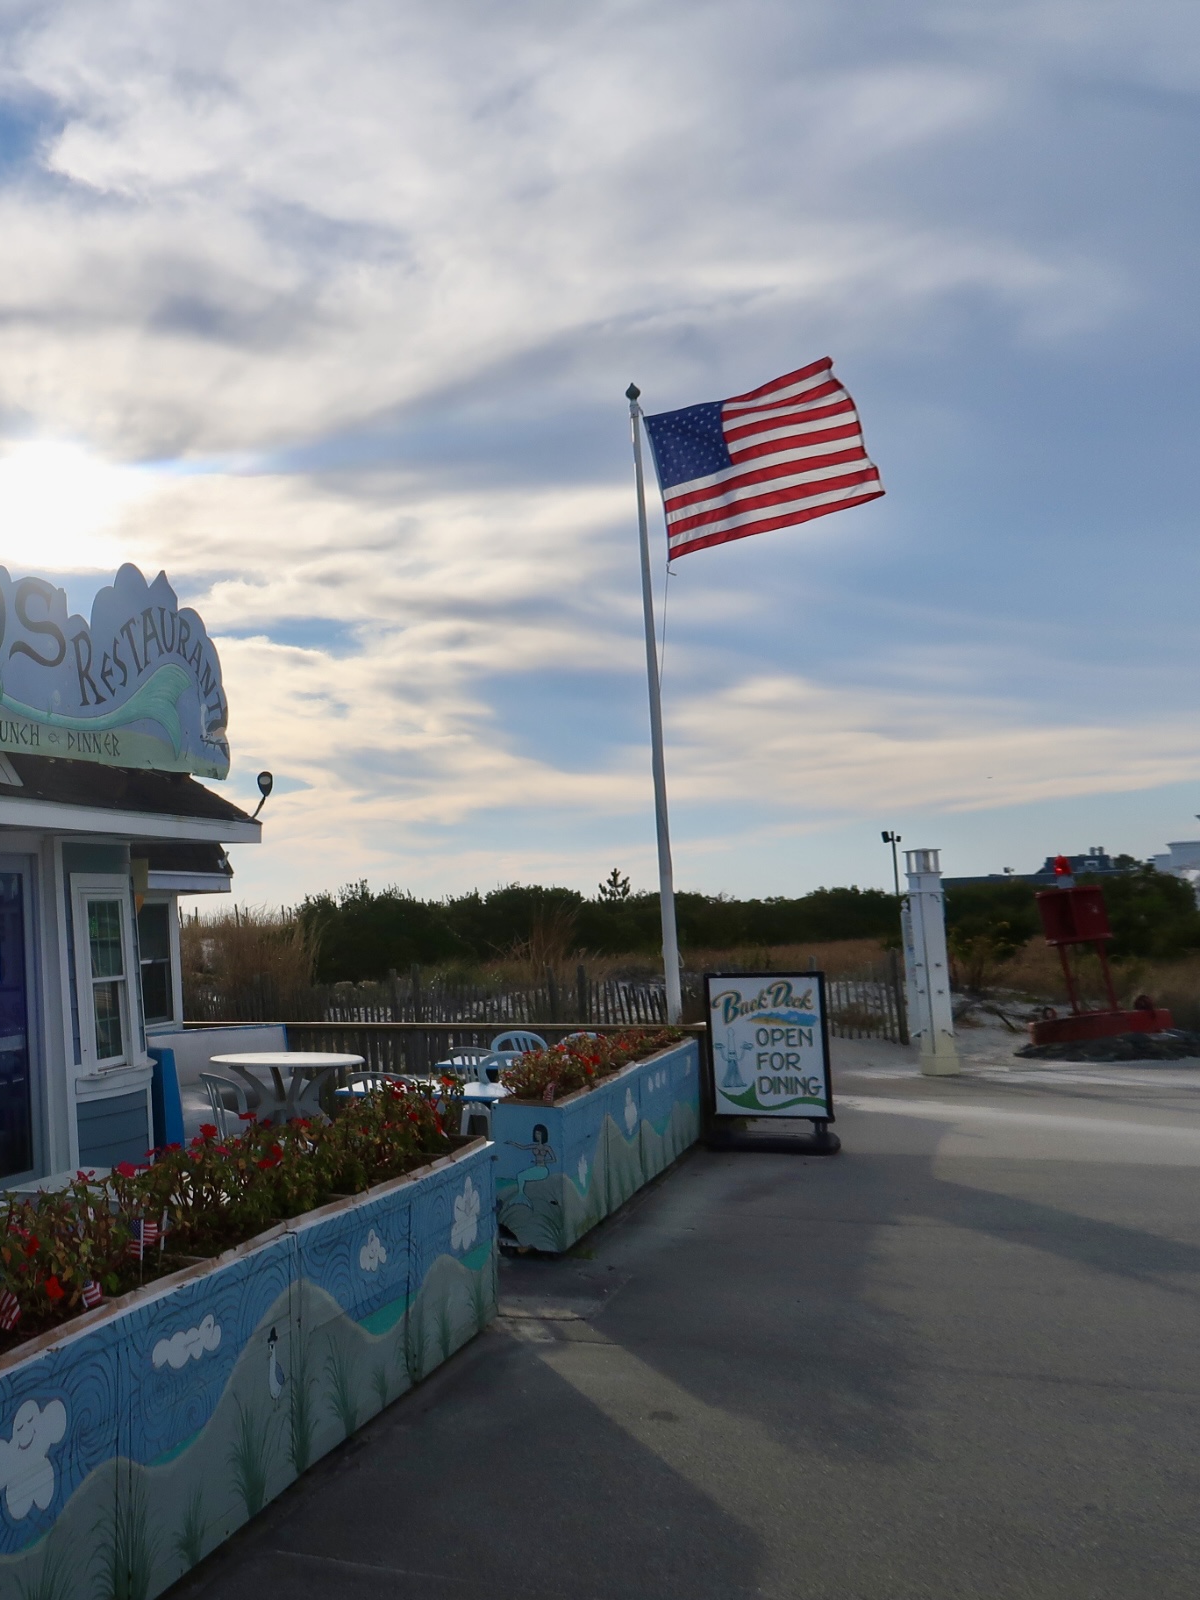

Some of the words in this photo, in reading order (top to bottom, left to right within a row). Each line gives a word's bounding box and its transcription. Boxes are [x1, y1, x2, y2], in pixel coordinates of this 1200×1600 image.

[70, 606, 224, 719] RESTAURANT
[67, 731, 121, 757] DINNER
[711, 989, 767, 1025] Back
[767, 980, 813, 1010] Deck
[755, 1028, 813, 1047] OPEN
[756, 1052, 802, 1071] FOR
[757, 1076, 822, 1096] DINING
